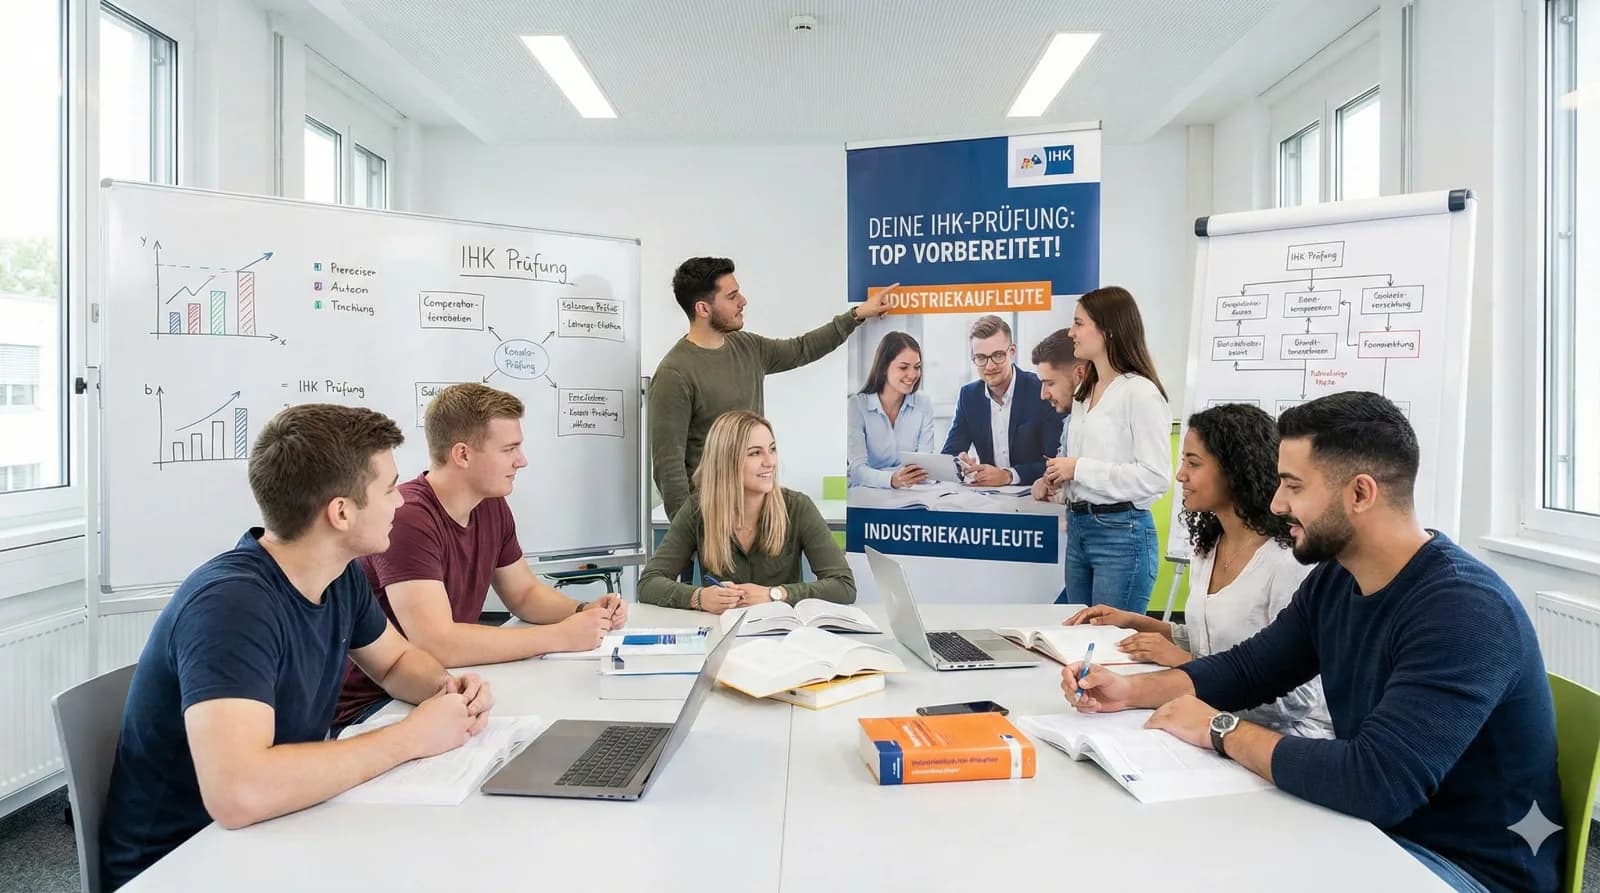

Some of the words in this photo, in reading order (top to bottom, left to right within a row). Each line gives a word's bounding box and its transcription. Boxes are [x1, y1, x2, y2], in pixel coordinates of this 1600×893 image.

[1048, 149, 1072, 162] IHK
[869, 214, 924, 239] DEINE
[931, 204, 1075, 235] IHK-PRÜFUNG:
[461, 245, 496, 269] IHK
[506, 248, 568, 284] Prüfung
[868, 244, 907, 266] TOP
[912, 236, 1061, 264] VORBEREITET!
[299, 380, 319, 393] IHK
[325, 380, 365, 399] Prüfung
[864, 522, 1044, 548] INDUSTRIEKAUFLEUTE
